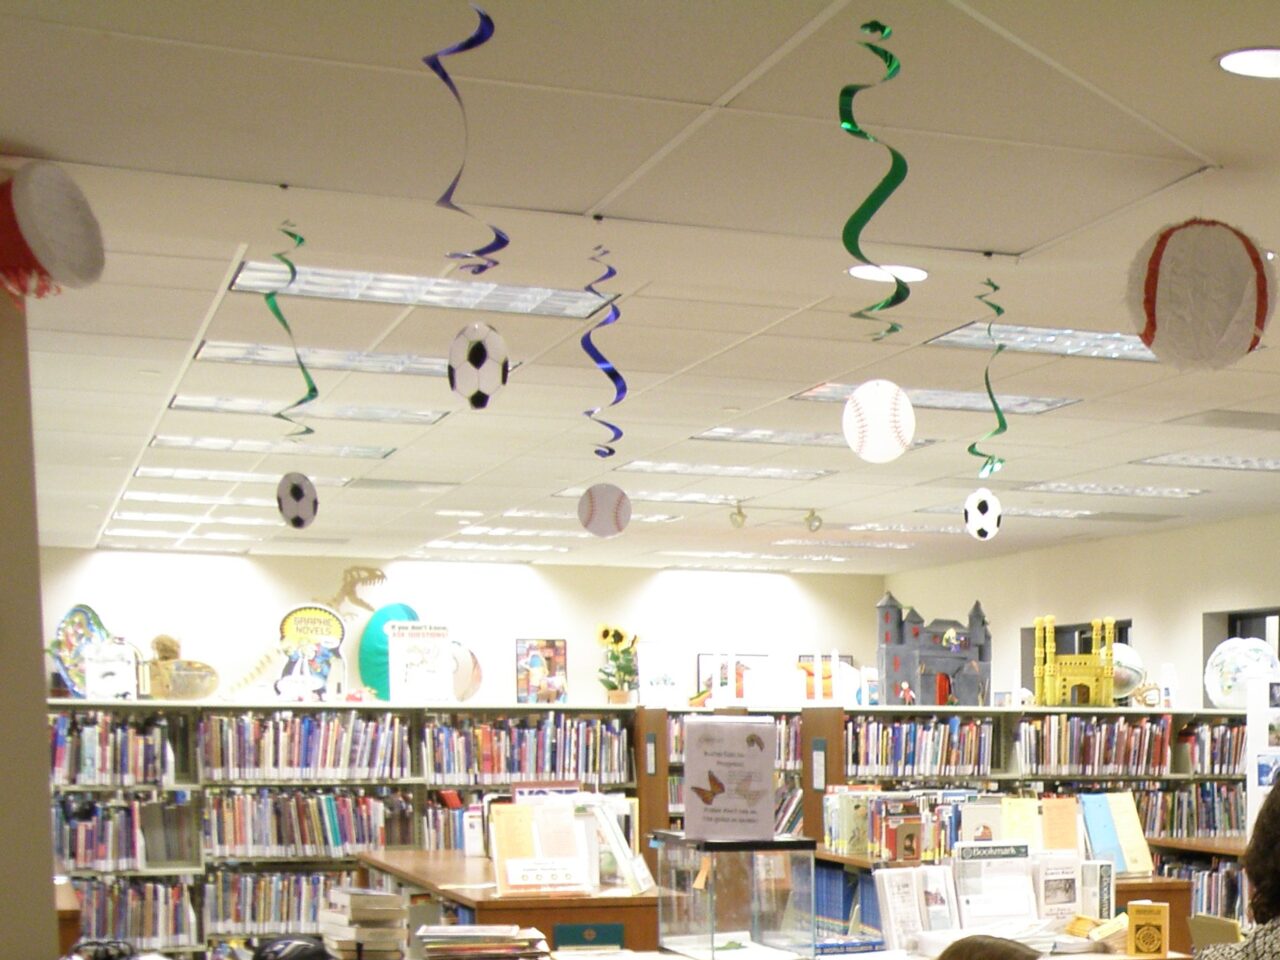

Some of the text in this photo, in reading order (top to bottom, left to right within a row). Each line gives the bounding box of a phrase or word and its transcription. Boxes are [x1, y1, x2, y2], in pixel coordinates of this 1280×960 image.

[293, 616, 333, 628] GRAPHIC
[296, 626, 332, 636] NOVELS
[973, 847, 1017, 858] Bookmark
